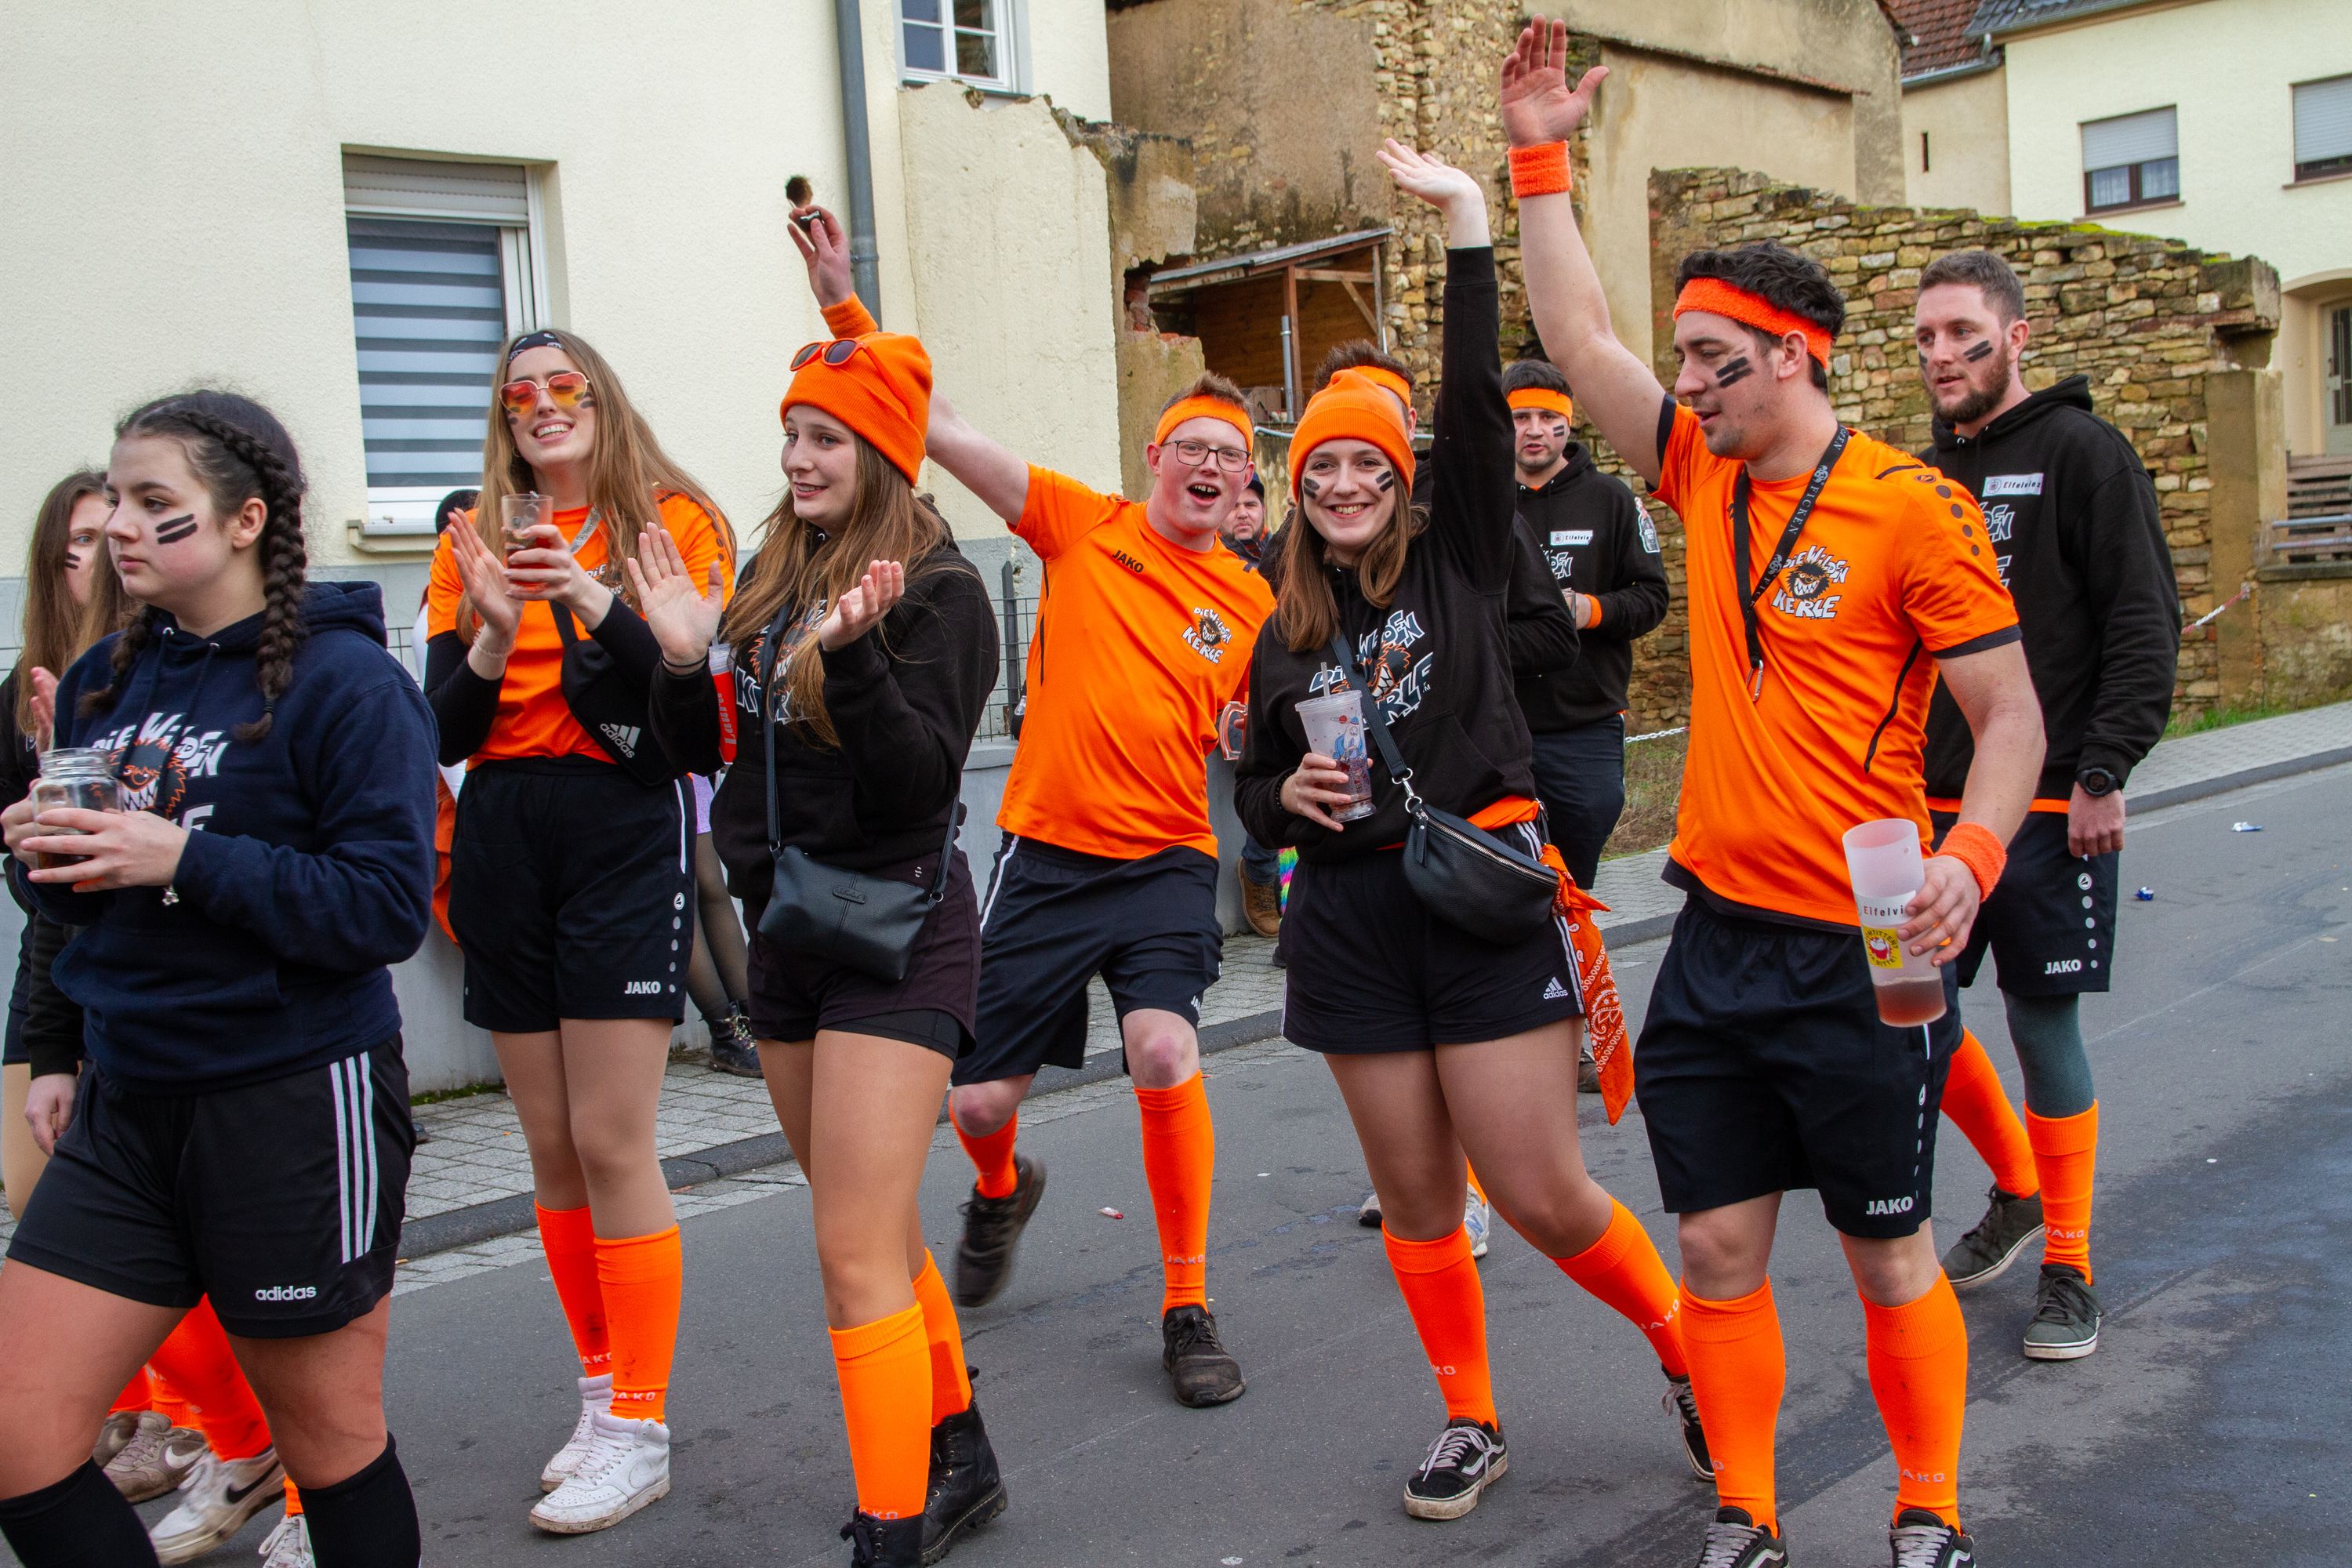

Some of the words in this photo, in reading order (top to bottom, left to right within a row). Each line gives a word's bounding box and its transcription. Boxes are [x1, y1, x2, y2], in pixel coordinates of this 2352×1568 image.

[1788, 485, 1820, 535] FICKEN
[1112, 550, 1144, 573] JAKO
[1771, 587, 1842, 619] KERLE
[1181, 626, 1224, 664] KERLE
[600, 723, 635, 758] adidas
[2045, 959, 2082, 975] JAKO
[625, 981, 661, 994] JAKO
[1544, 989, 1568, 999] adidas
[1866, 1196, 1914, 1214] JAKO
[256, 1286, 317, 1301] adidas
[1903, 1468, 1944, 1483] AKO
